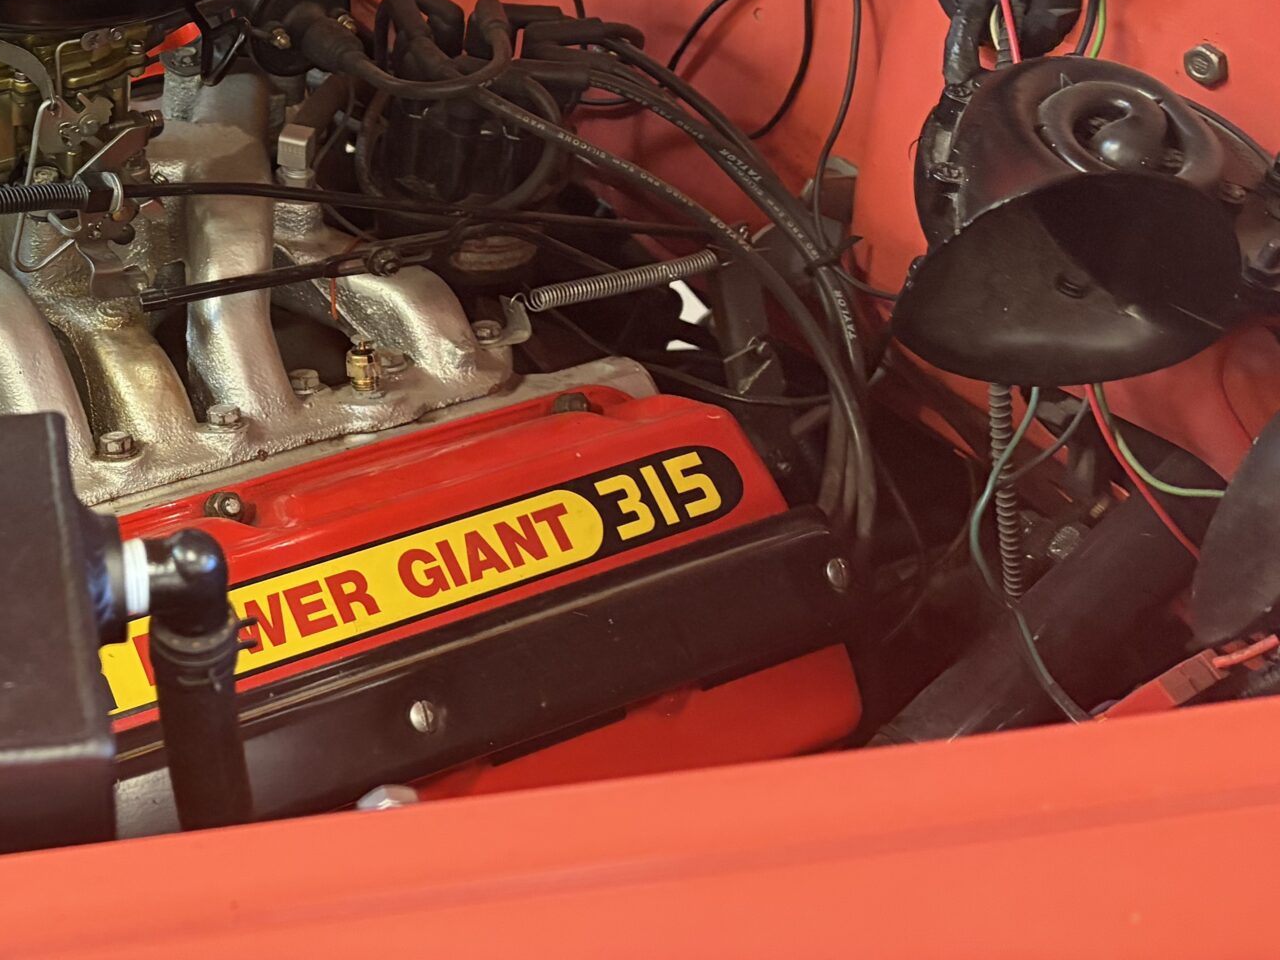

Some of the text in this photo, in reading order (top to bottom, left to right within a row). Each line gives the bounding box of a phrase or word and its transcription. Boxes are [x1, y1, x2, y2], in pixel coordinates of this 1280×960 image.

[557, 130, 606, 159] SILICONE
[639, 172, 661, 187] PRO
[719, 147, 763, 182] TAYLOR
[708, 215, 751, 252] TAYLOR
[833, 289, 857, 340] TAYLOR
[396, 502, 577, 598] GIANT
[593, 451, 722, 541] 315
